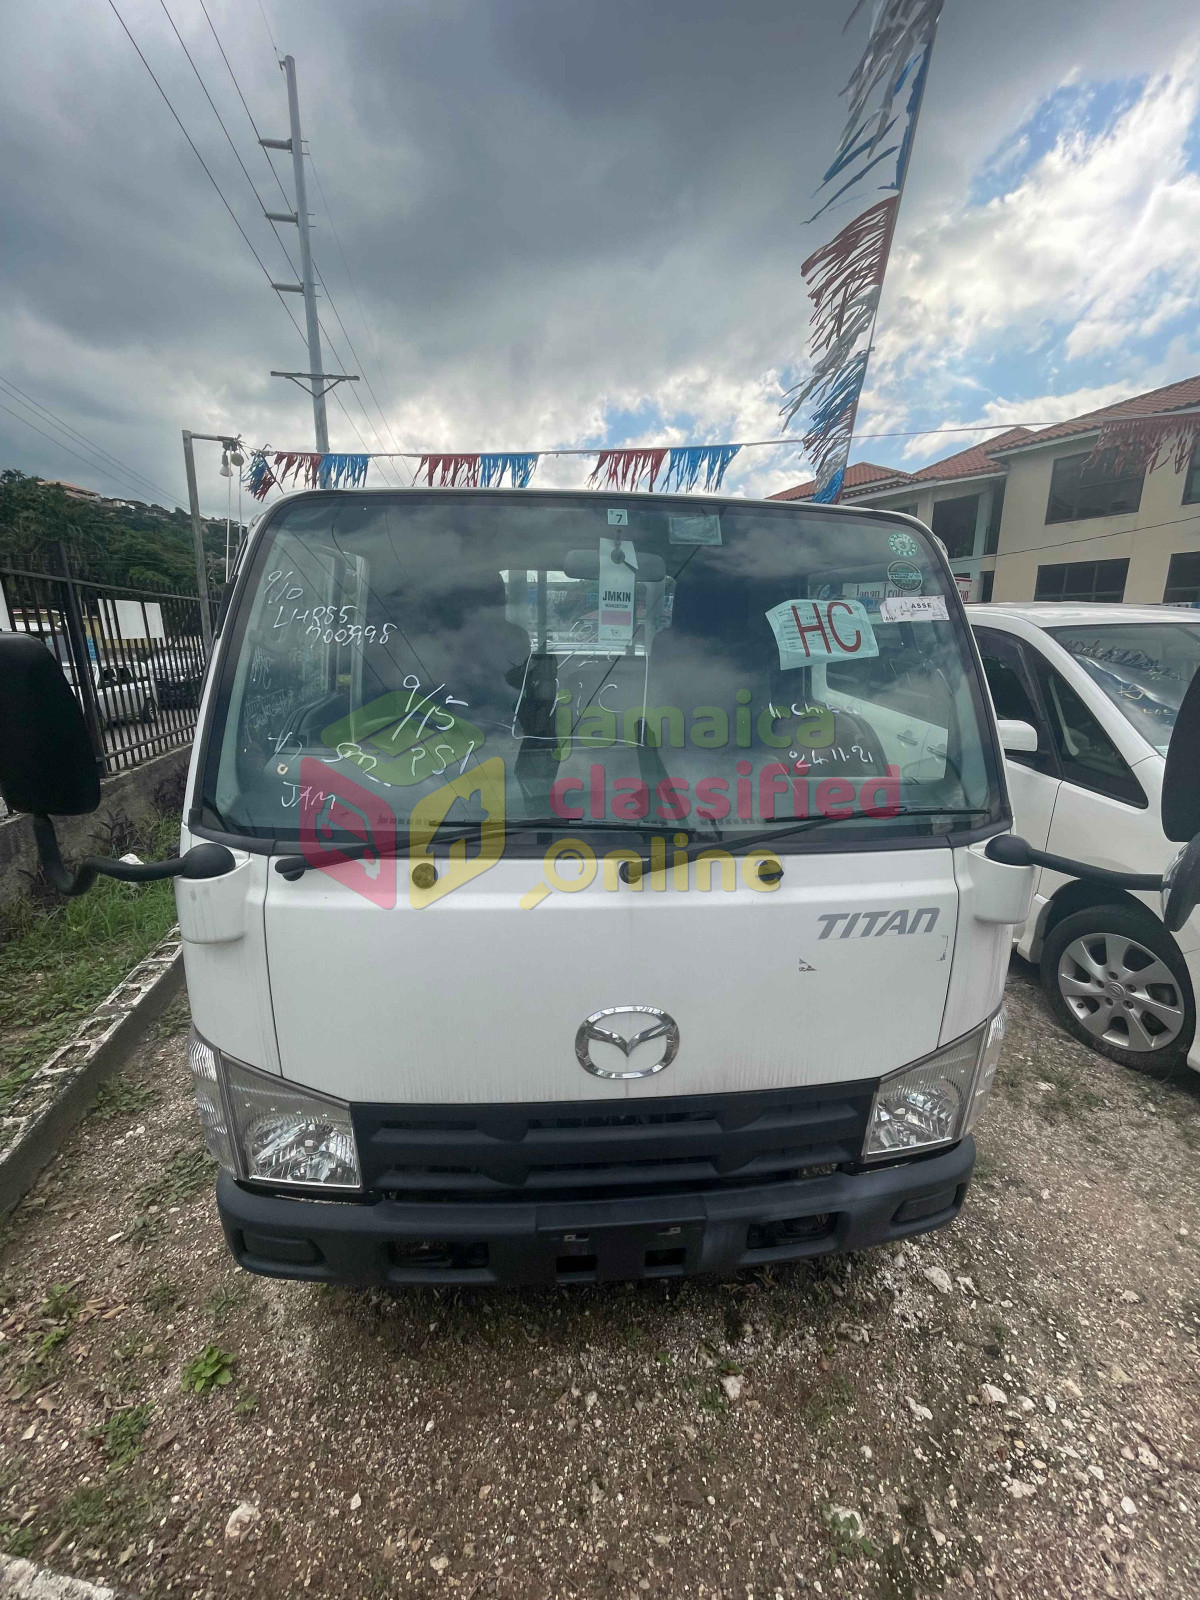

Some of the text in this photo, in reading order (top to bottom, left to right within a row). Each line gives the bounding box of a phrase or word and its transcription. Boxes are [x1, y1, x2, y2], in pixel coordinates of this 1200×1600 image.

[615, 513, 623, 524] 7
[602, 590, 631, 602] JMKIN
[790, 601, 862, 658] HC
[817, 907, 940, 940] TITAN
